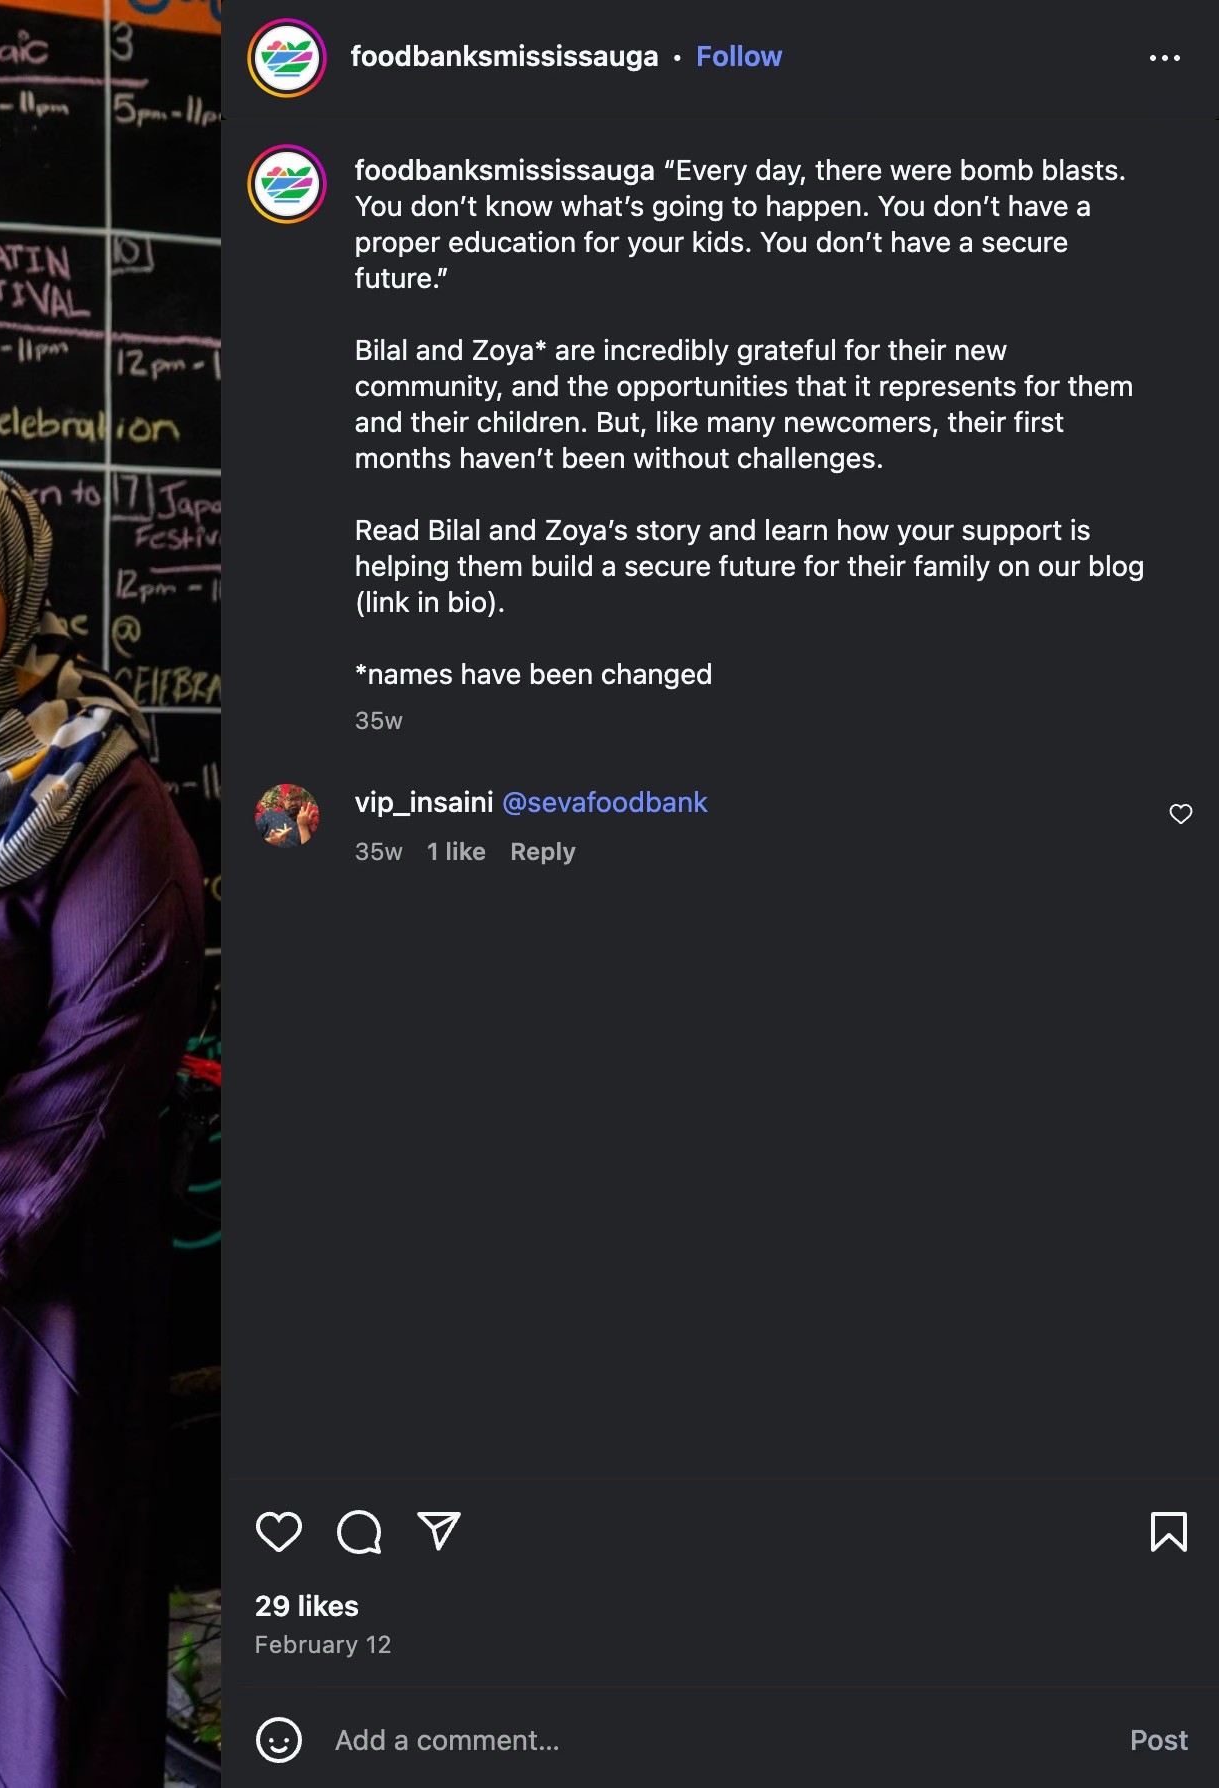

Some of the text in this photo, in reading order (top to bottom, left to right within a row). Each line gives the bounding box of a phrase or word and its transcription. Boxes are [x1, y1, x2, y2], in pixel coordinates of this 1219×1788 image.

[111, 22, 134, 61] 3
[113, 474, 139, 511] 17
[134, 523, 221, 550] Festiv
[111, 614, 142, 659] @
